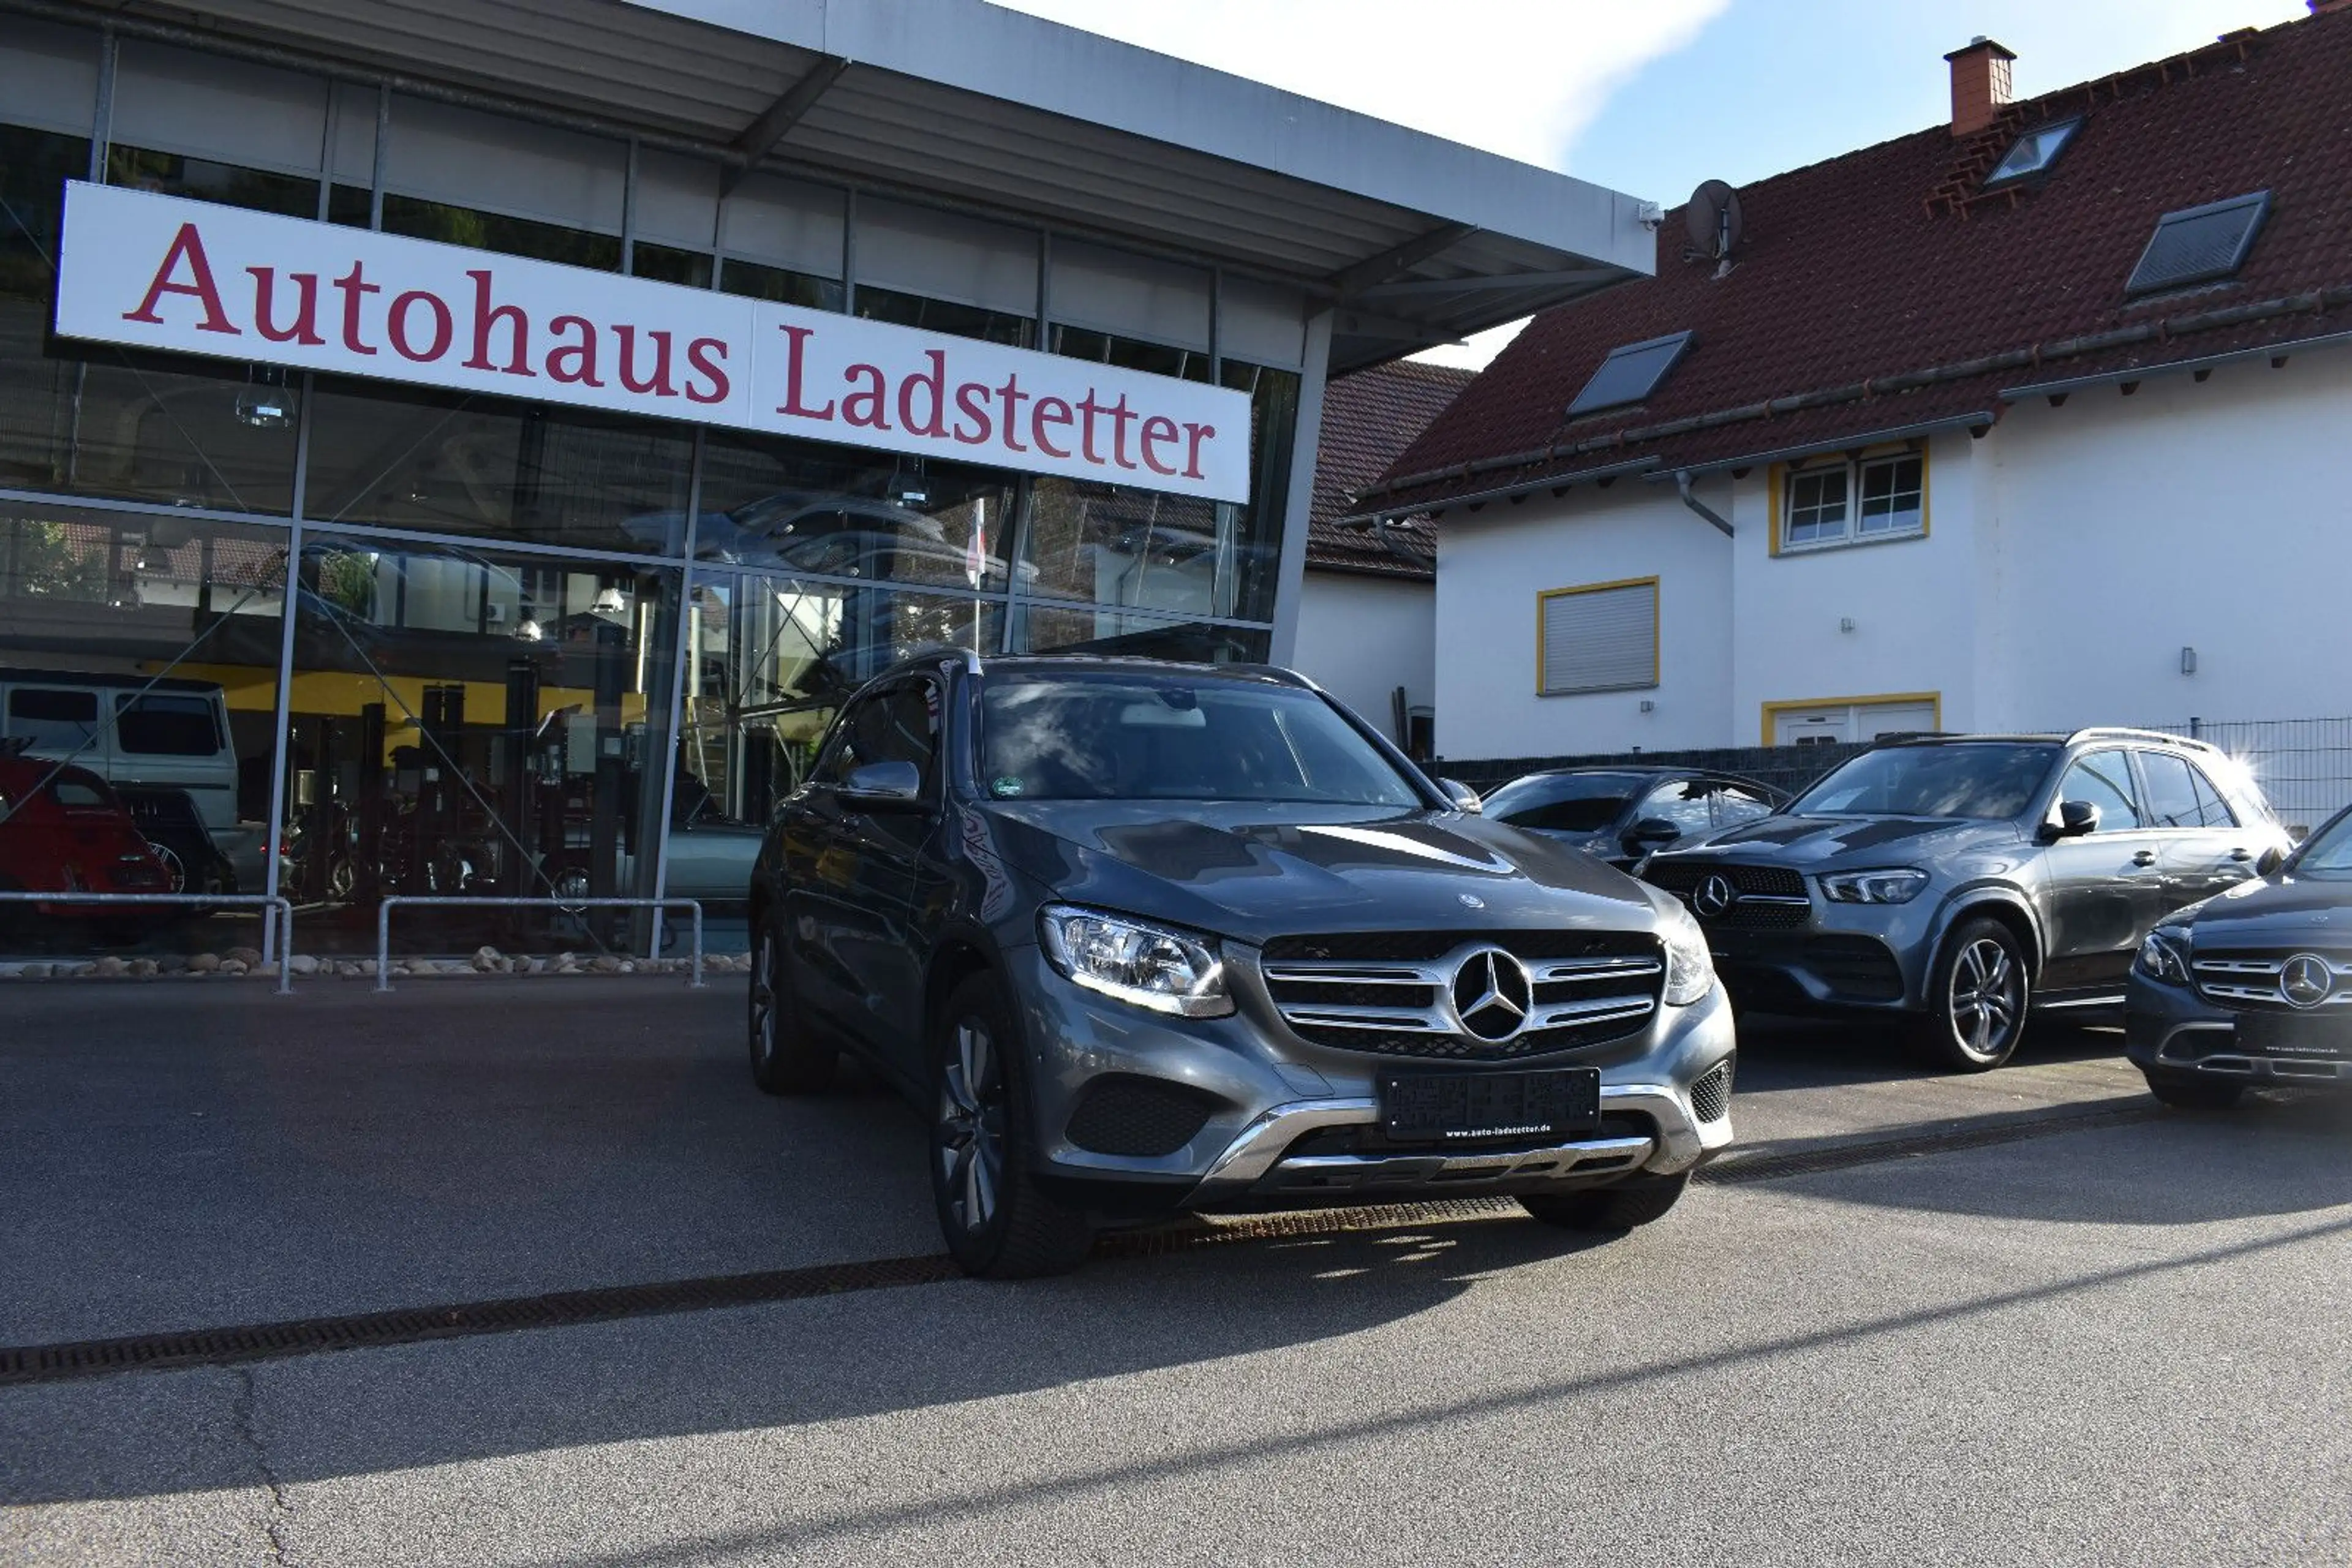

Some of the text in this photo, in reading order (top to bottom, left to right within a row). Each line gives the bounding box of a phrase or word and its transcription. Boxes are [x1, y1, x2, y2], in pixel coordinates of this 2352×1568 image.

[121, 222, 1216, 480] Autohaus Ladstetter
[1446, 1124, 1551, 1137] www.auto-ladstetter.de
